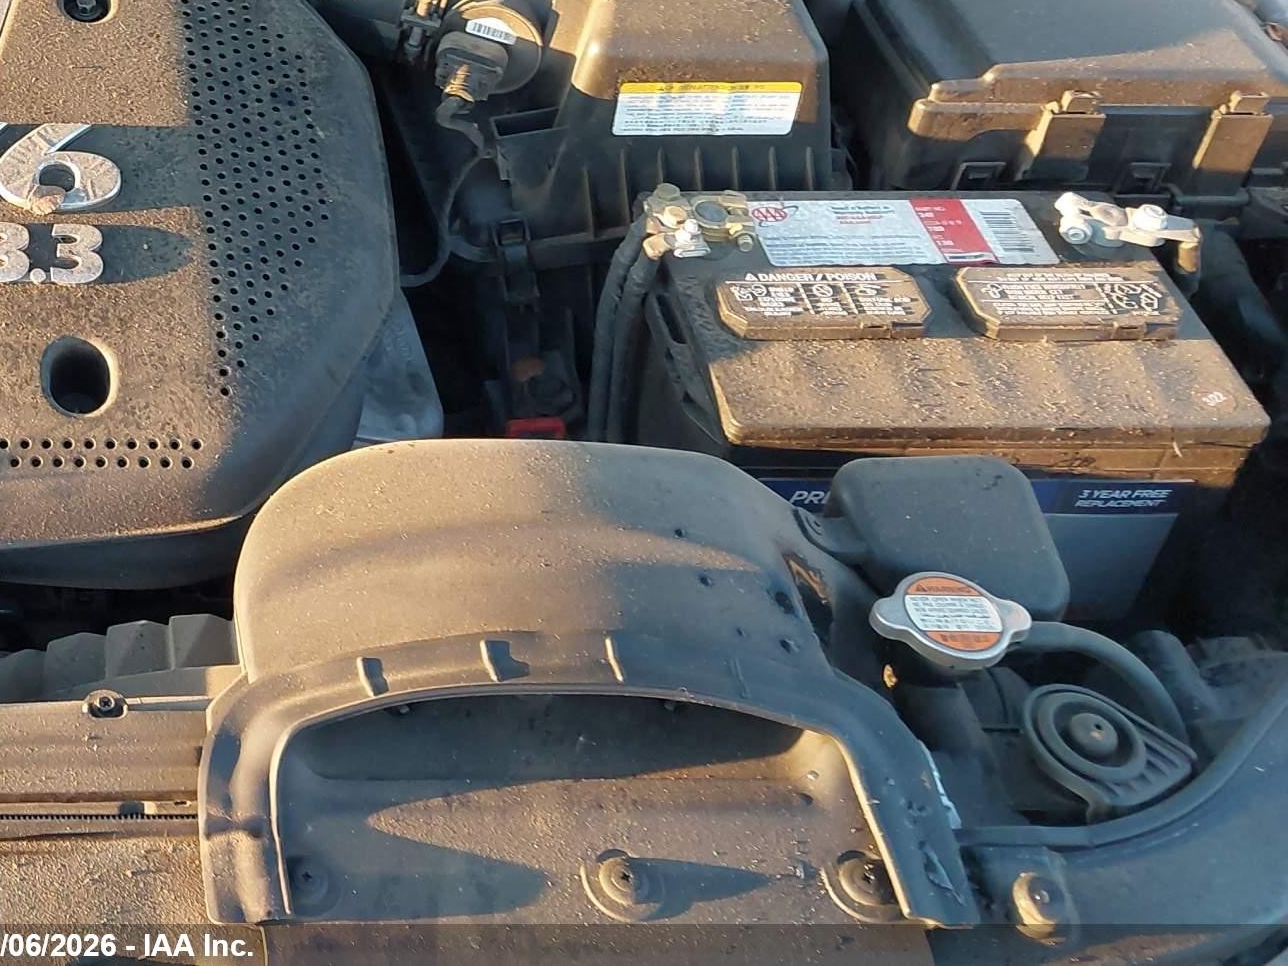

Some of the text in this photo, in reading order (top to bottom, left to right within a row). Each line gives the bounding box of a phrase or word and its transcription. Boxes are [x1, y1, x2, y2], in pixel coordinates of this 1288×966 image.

[757, 273, 812, 282] DANGER
[825, 273, 878, 282] POISON
[1078, 489, 1173, 499] 3 YEAR FREE
[1074, 499, 1167, 508] REPLACEMENT
